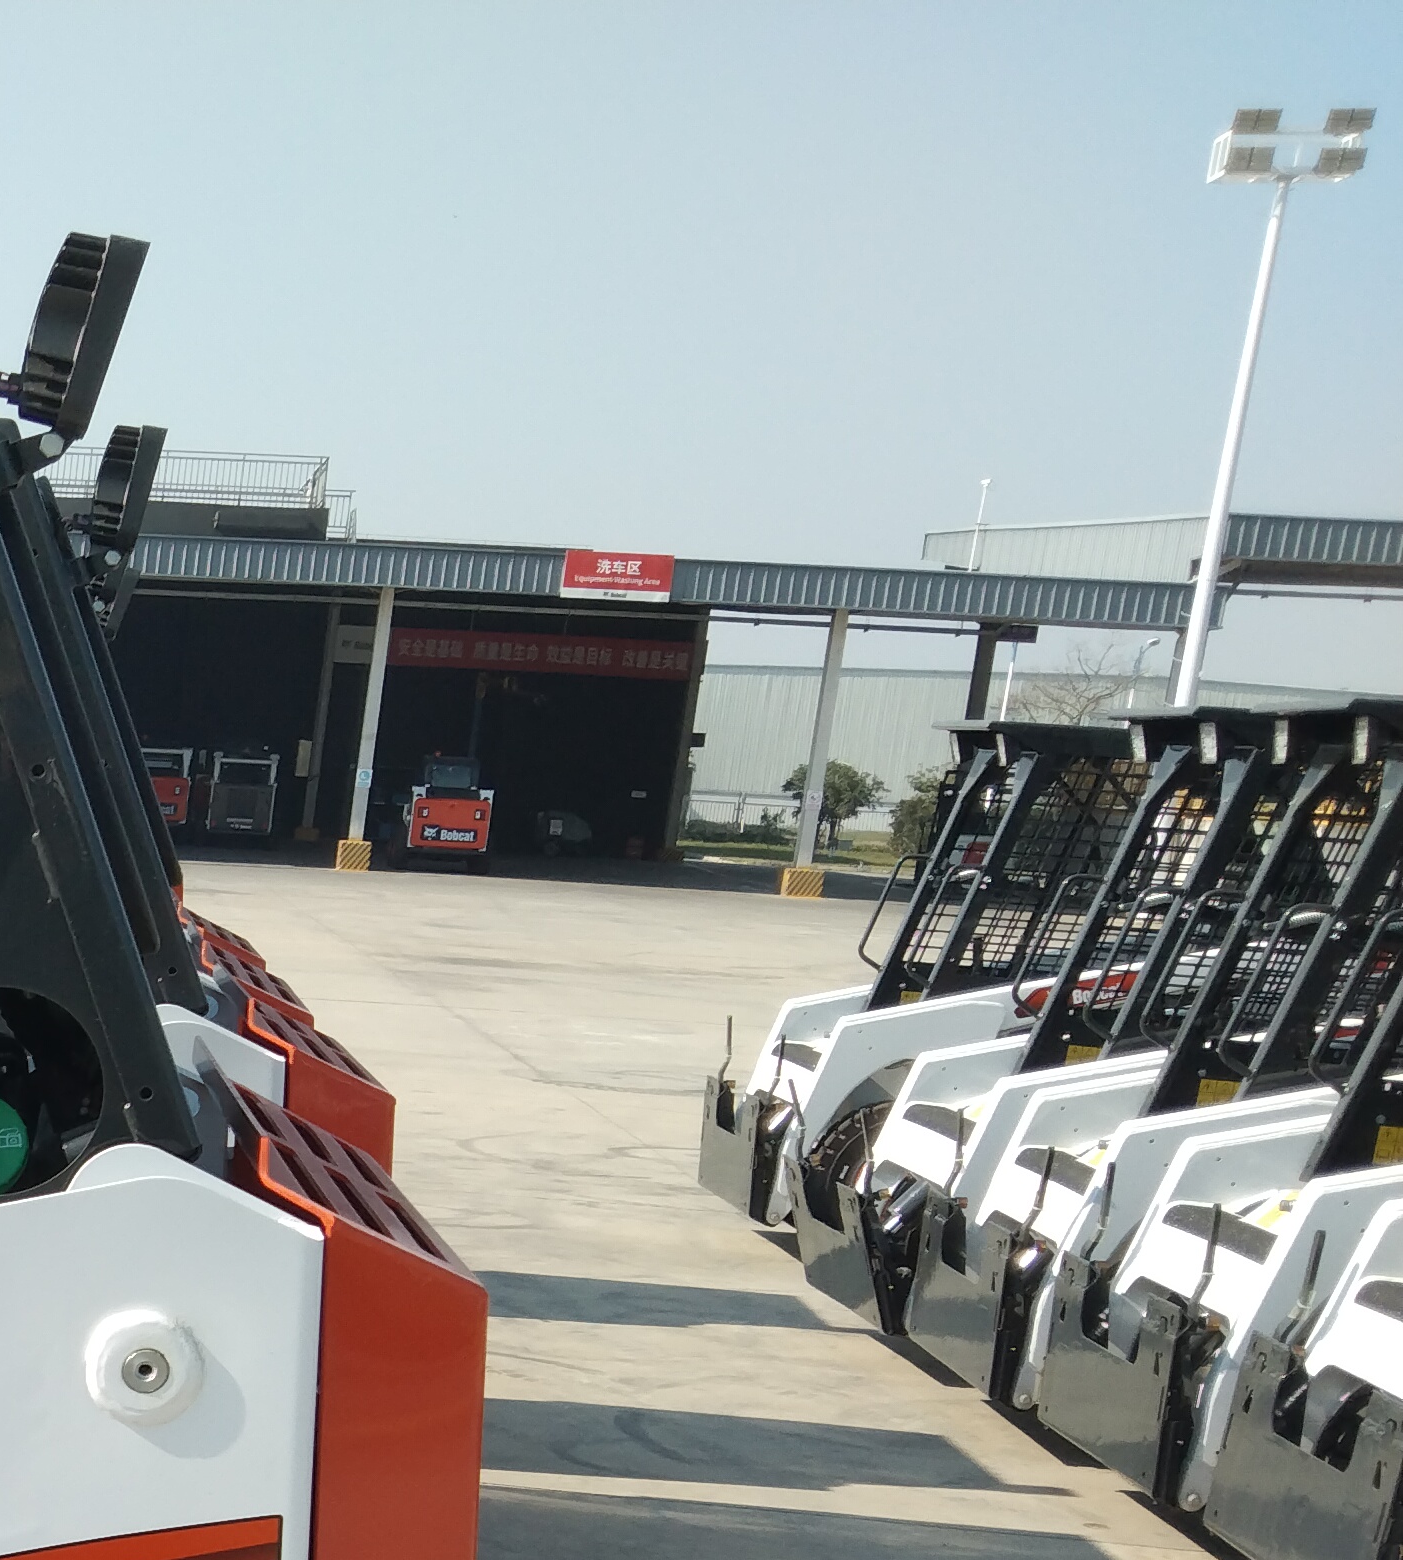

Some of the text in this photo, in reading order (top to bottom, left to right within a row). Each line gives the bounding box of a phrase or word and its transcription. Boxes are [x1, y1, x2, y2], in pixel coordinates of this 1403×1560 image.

[596, 558, 643, 576] 洗车区
[439, 829, 476, 842] Bobcat
